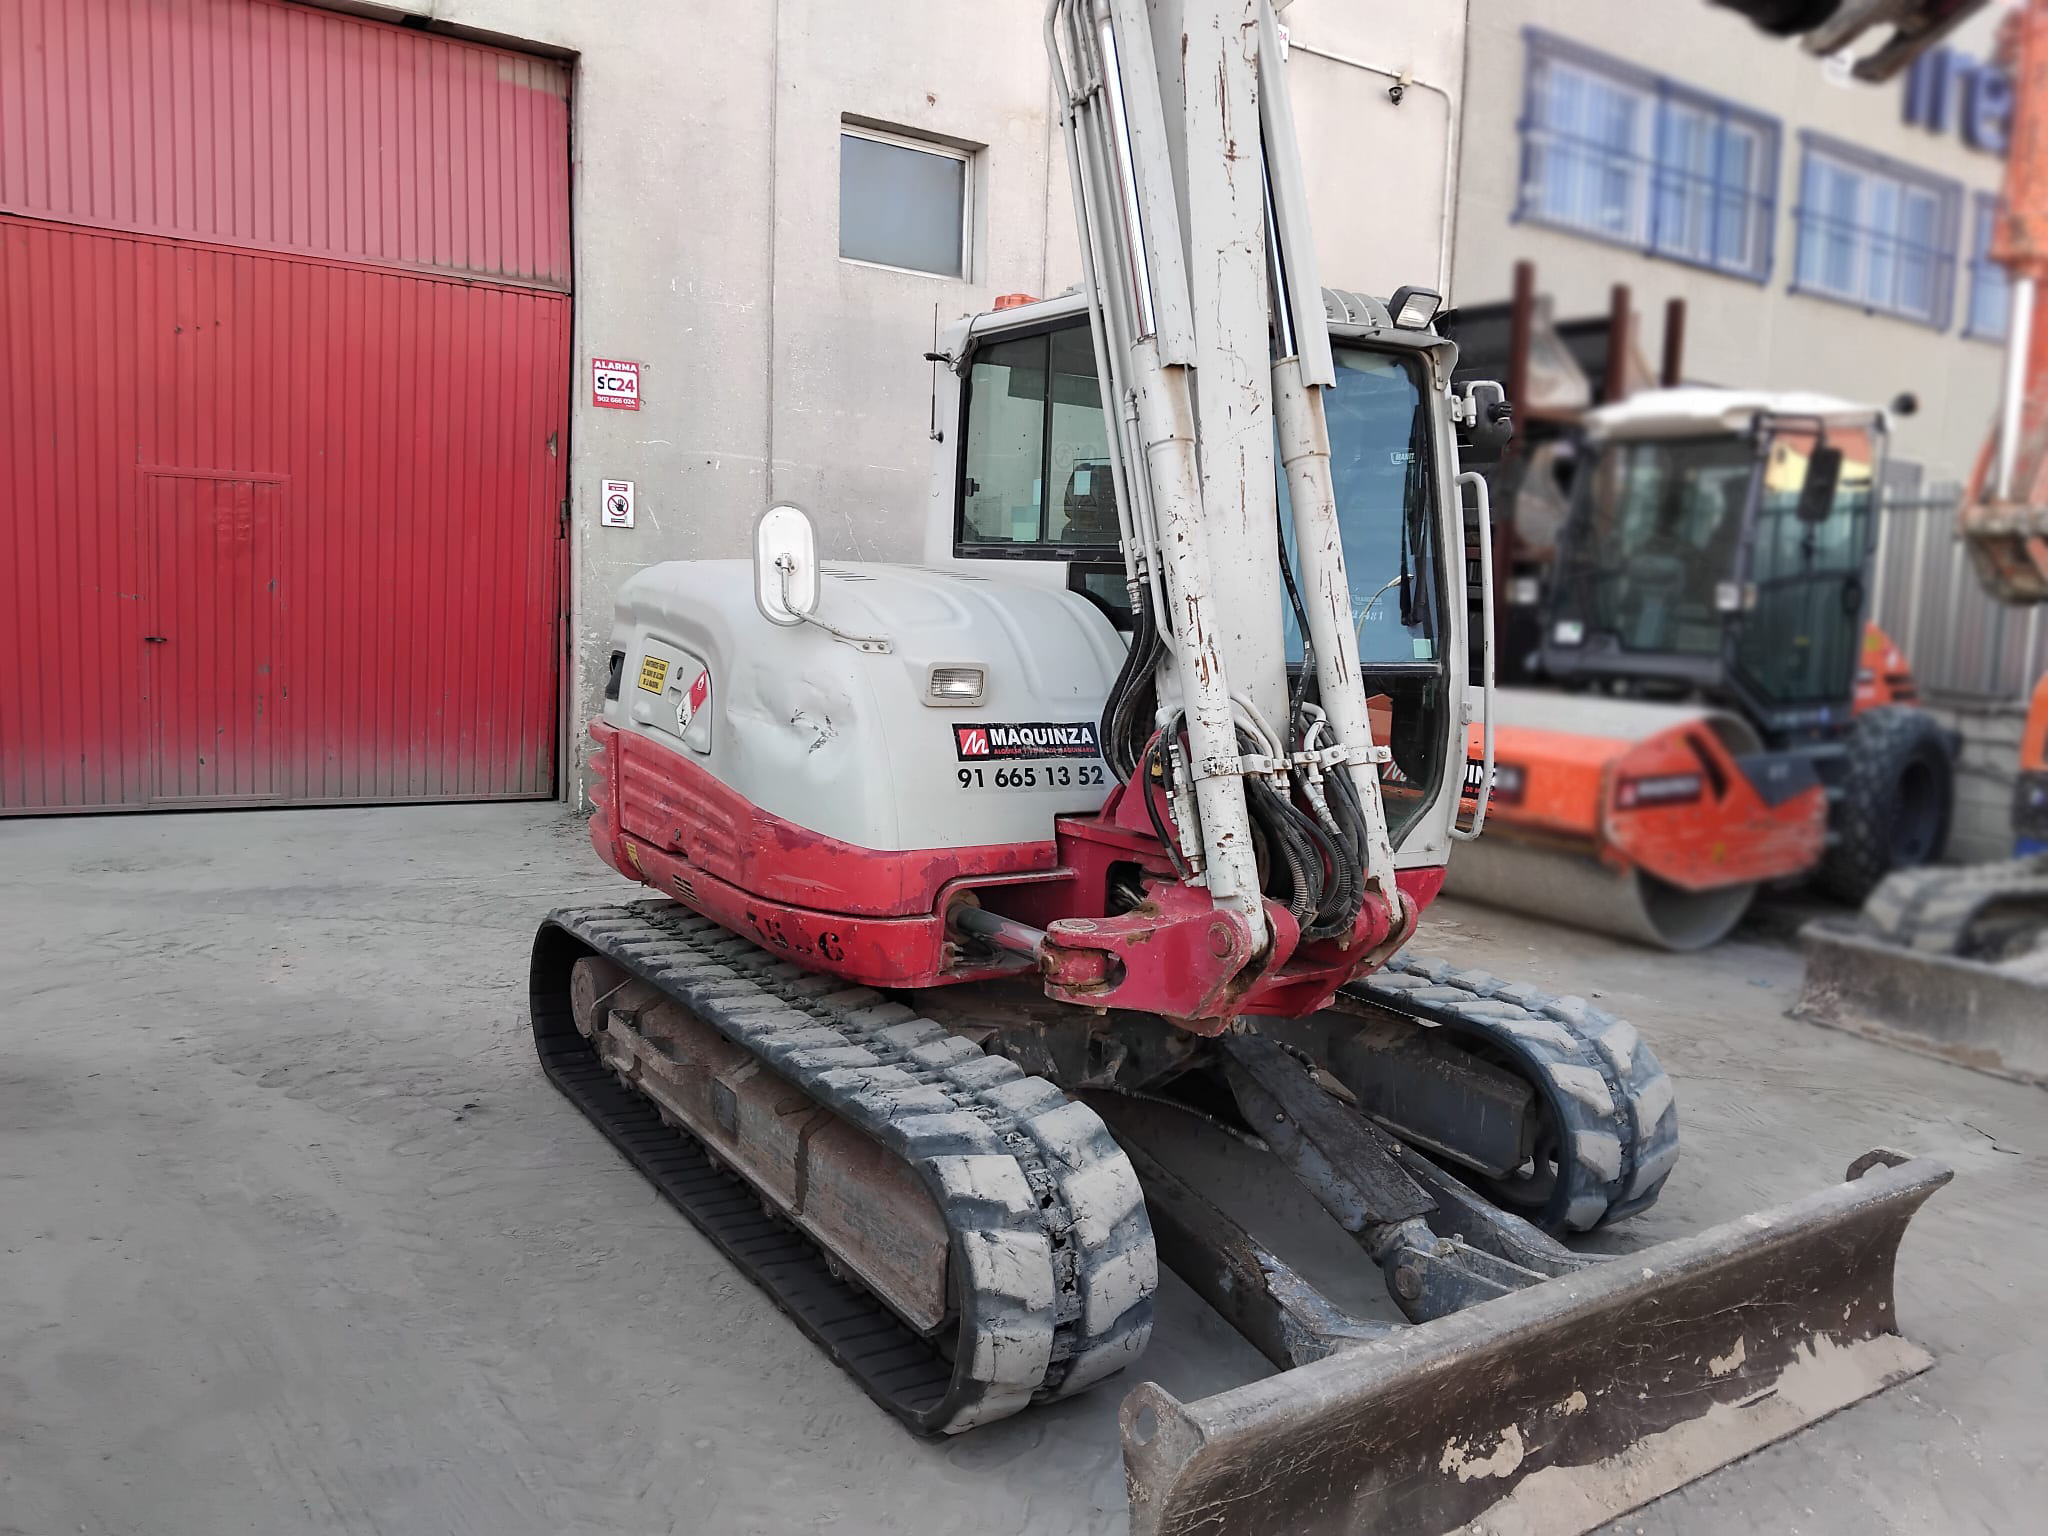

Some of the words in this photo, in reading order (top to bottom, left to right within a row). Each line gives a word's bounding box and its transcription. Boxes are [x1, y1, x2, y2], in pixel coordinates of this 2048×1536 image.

[594, 360, 637, 373] ALARMA
[989, 728, 1094, 746] MAQUINZA
[957, 768, 984, 788] 91
[995, 767, 1036, 788] 665
[1045, 766, 1071, 786] 13
[1078, 765, 1104, 785] 52
